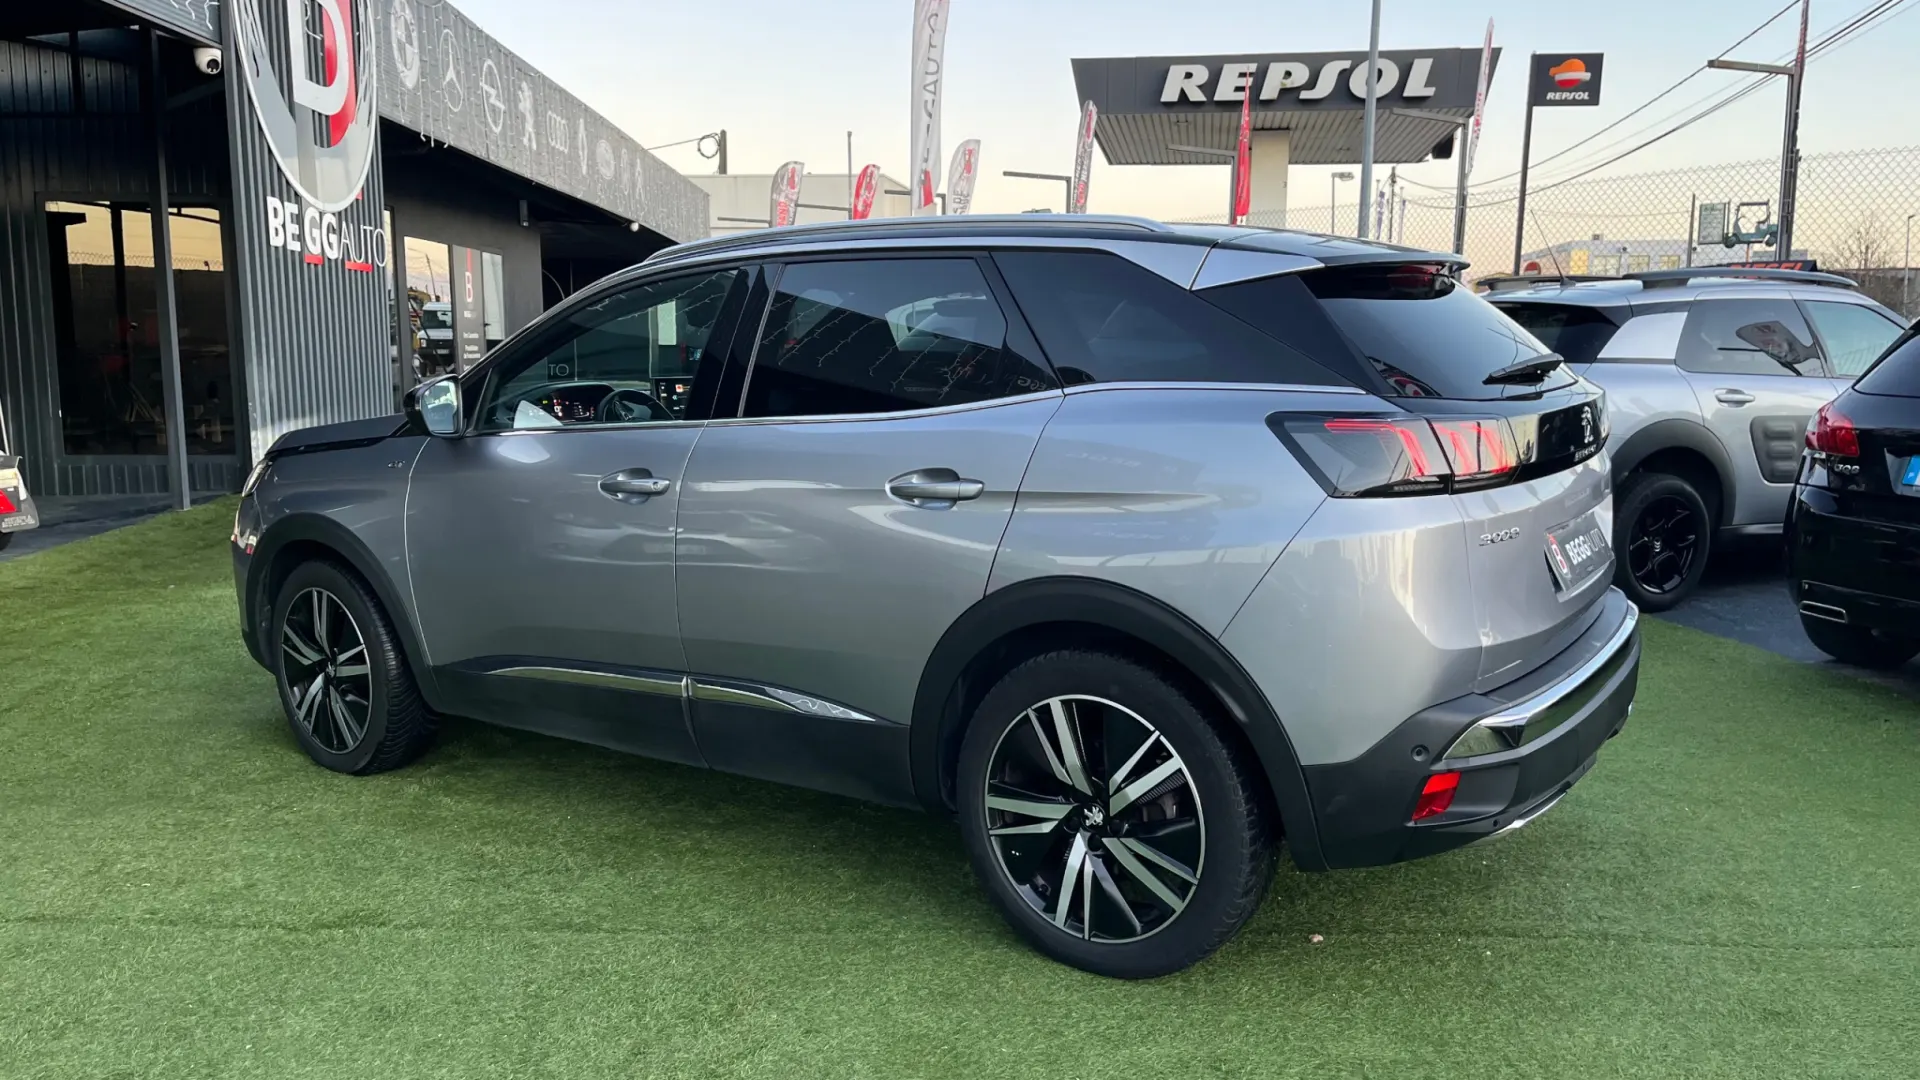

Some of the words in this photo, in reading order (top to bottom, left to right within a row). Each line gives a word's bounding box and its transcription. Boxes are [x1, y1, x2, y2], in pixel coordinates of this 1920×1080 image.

[1160, 58, 1436, 102] REPSOL
[1546, 91, 1590, 101] REPSOL
[1479, 527, 1520, 547] 3008
[1565, 528, 1605, 566] BEGGAUTO
